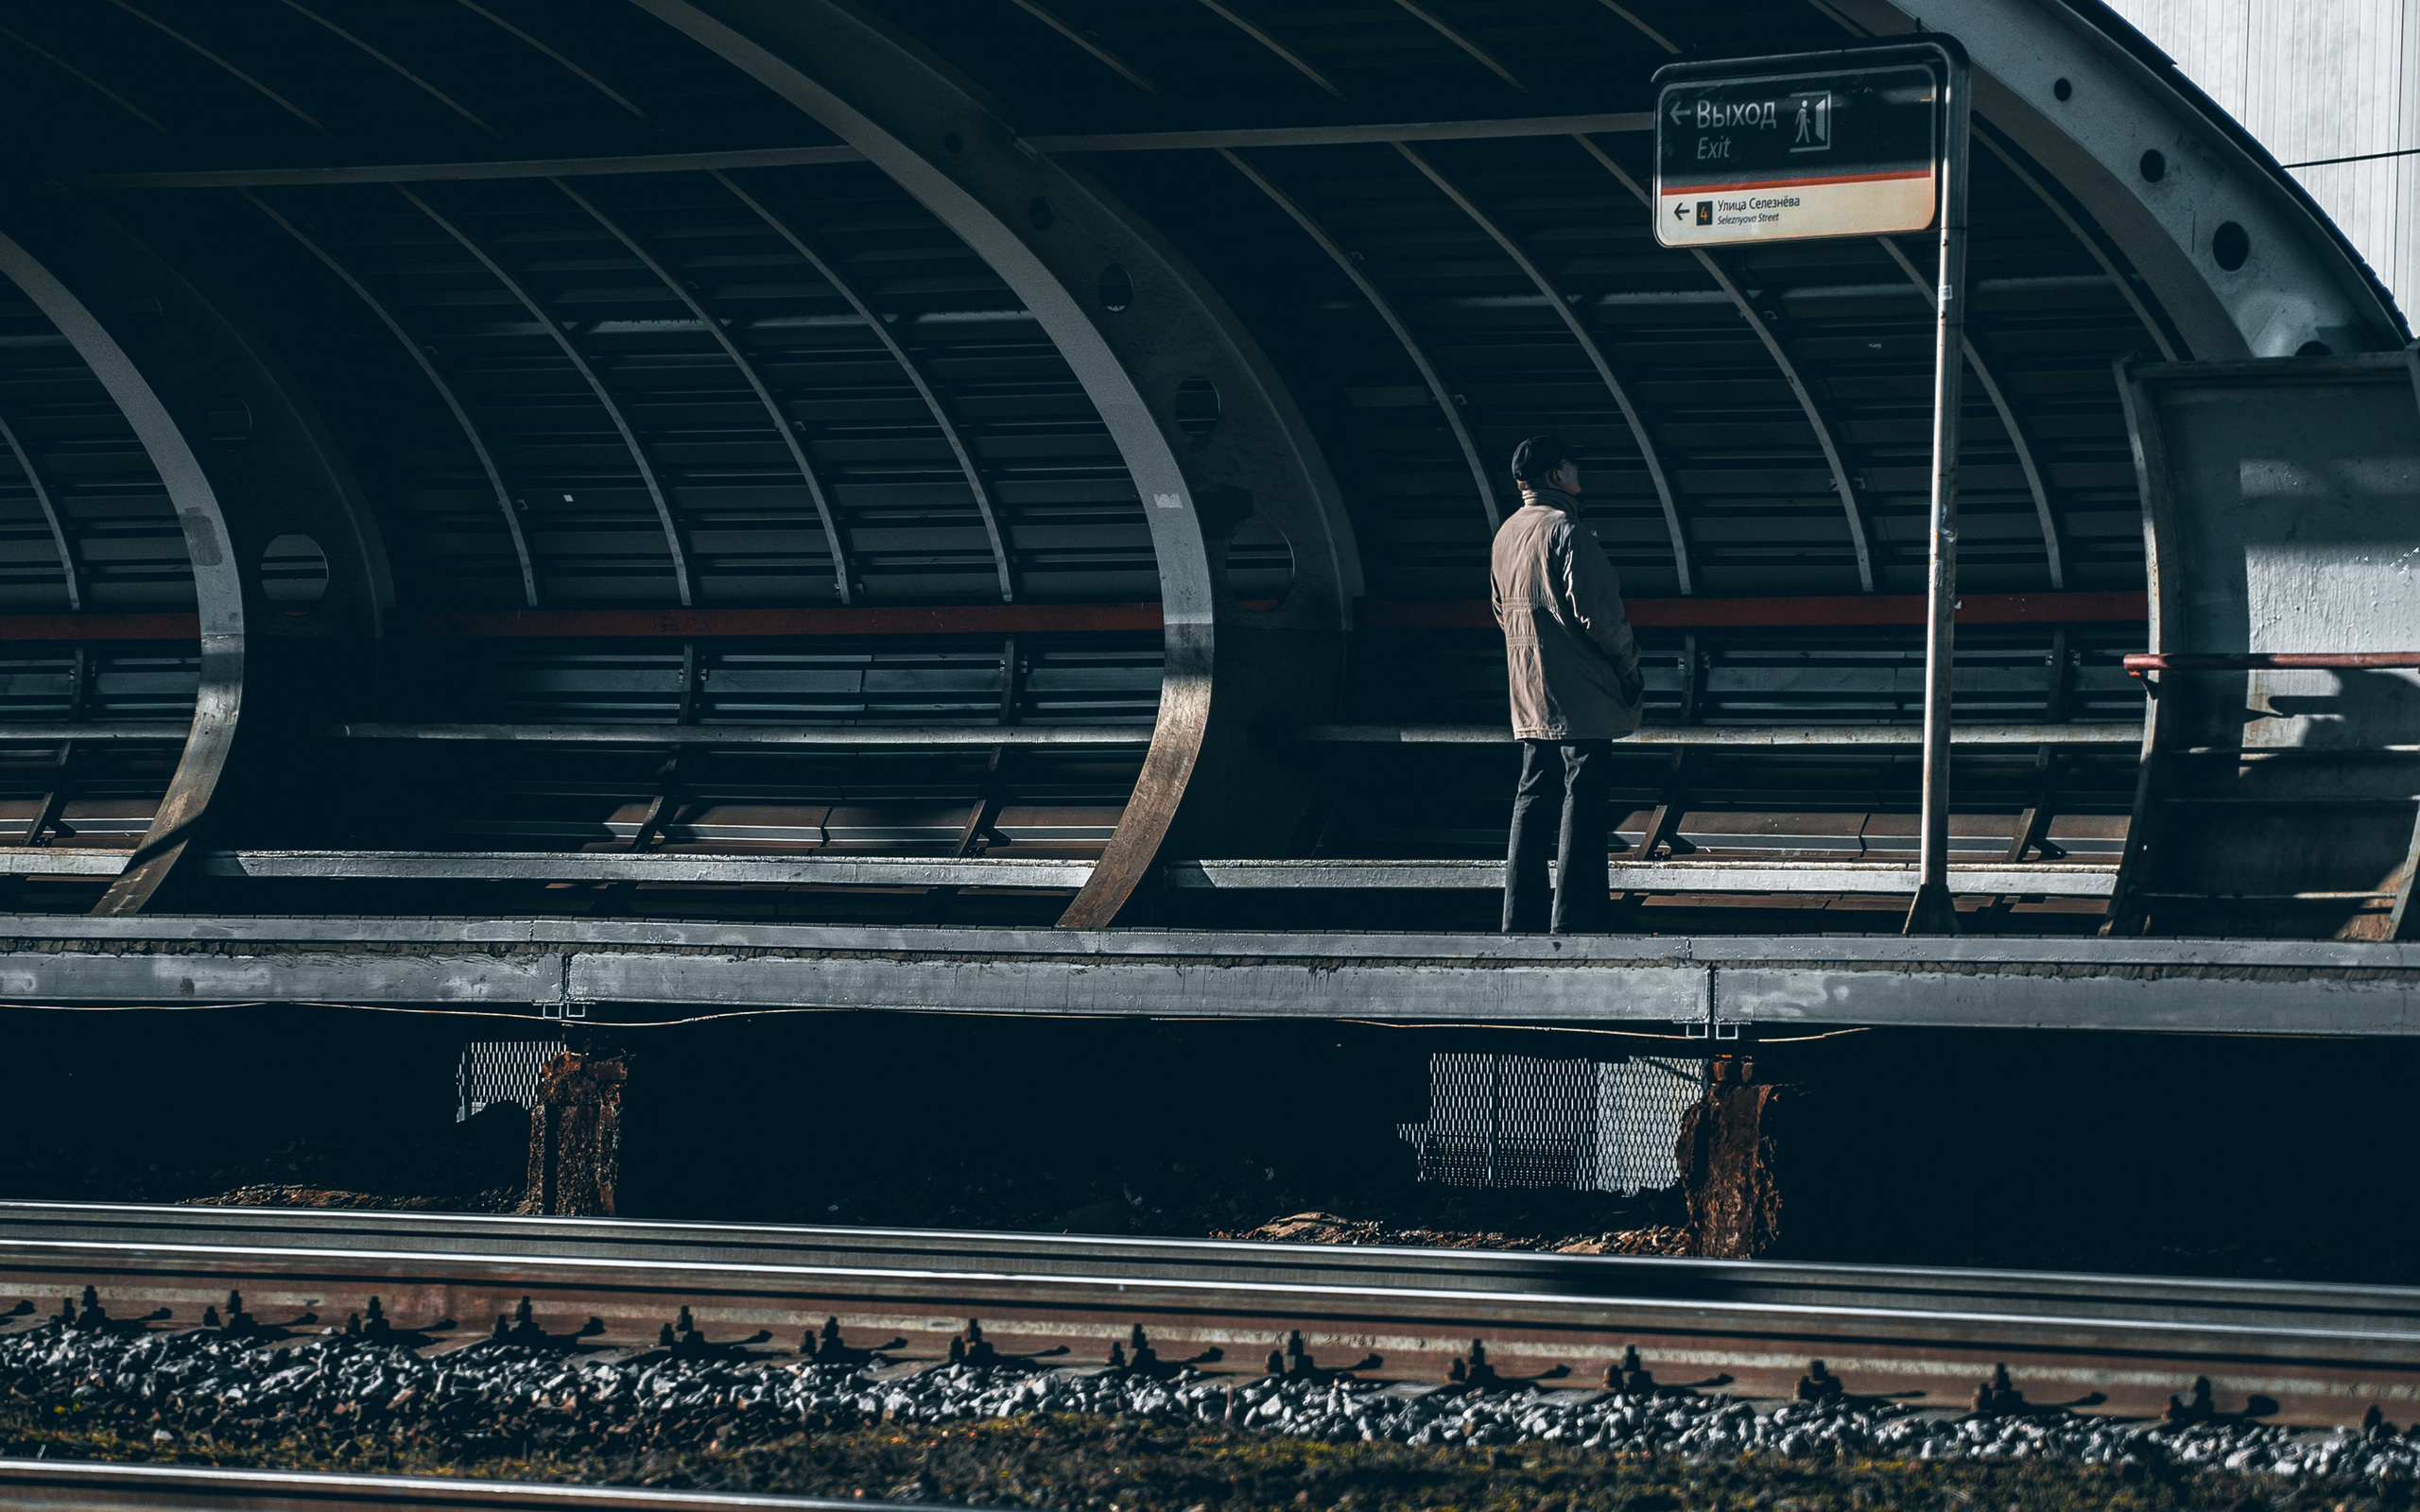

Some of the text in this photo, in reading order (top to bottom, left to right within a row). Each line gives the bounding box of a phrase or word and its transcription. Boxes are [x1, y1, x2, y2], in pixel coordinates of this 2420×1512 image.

[1697, 99, 1776, 129] Выход
[1697, 135, 1731, 160] Exit
[1718, 195, 1800, 213] Улица Селезнёва
[1700, 206, 1708, 221] 4
[1717, 213, 1779, 226] Seleznyova Street
